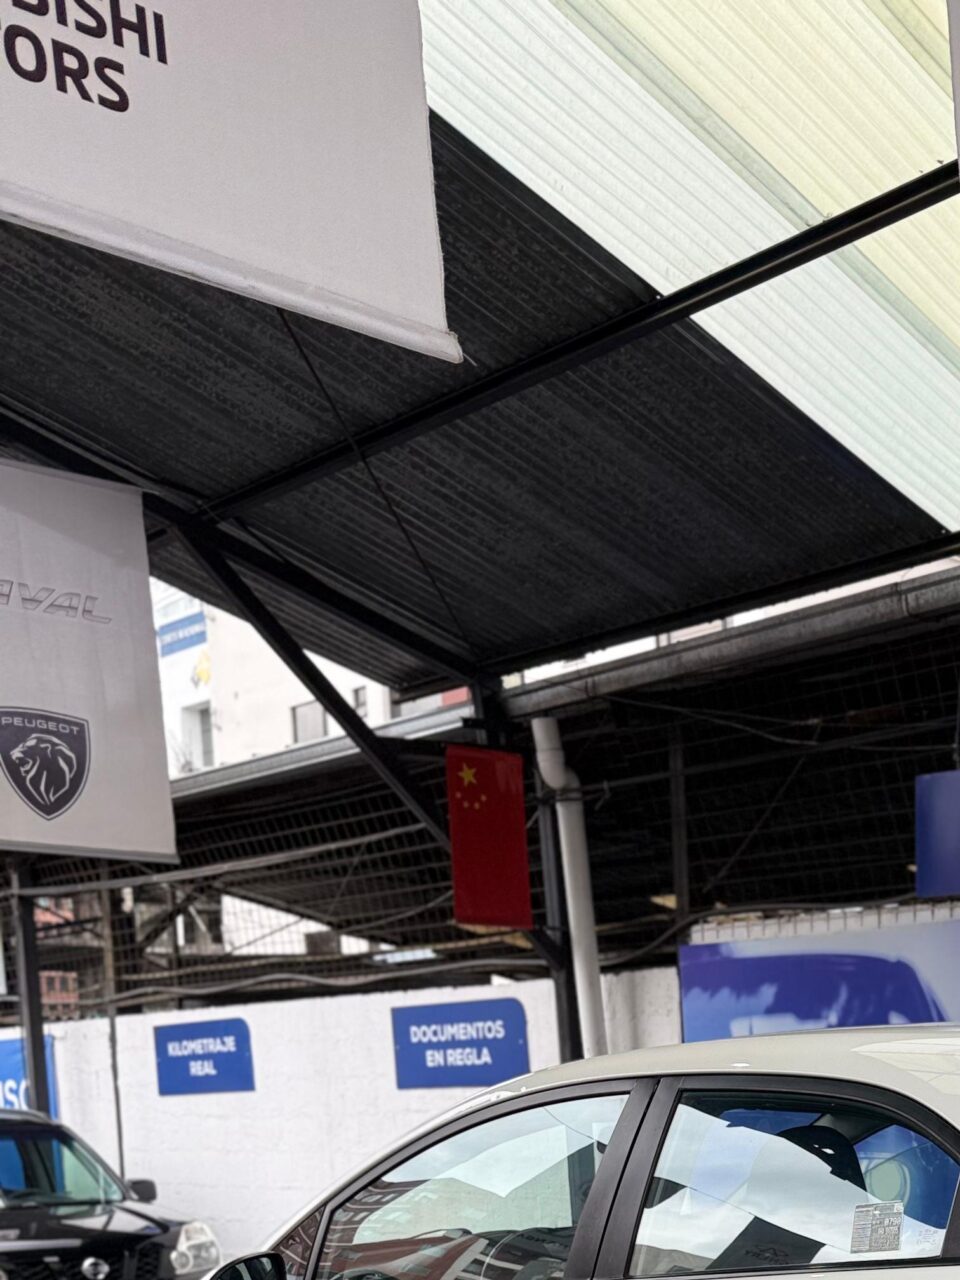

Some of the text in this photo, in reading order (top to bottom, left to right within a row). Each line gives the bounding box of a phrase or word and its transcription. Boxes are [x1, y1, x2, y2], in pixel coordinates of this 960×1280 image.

[1, 716, 80, 735] PEUGEOT
[409, 1020, 505, 1043] DOCUMENTOS
[167, 1036, 237, 1057] KILOMETRAJE
[188, 1059, 218, 1077] REAL
[425, 1047, 492, 1068] EN REGLA
